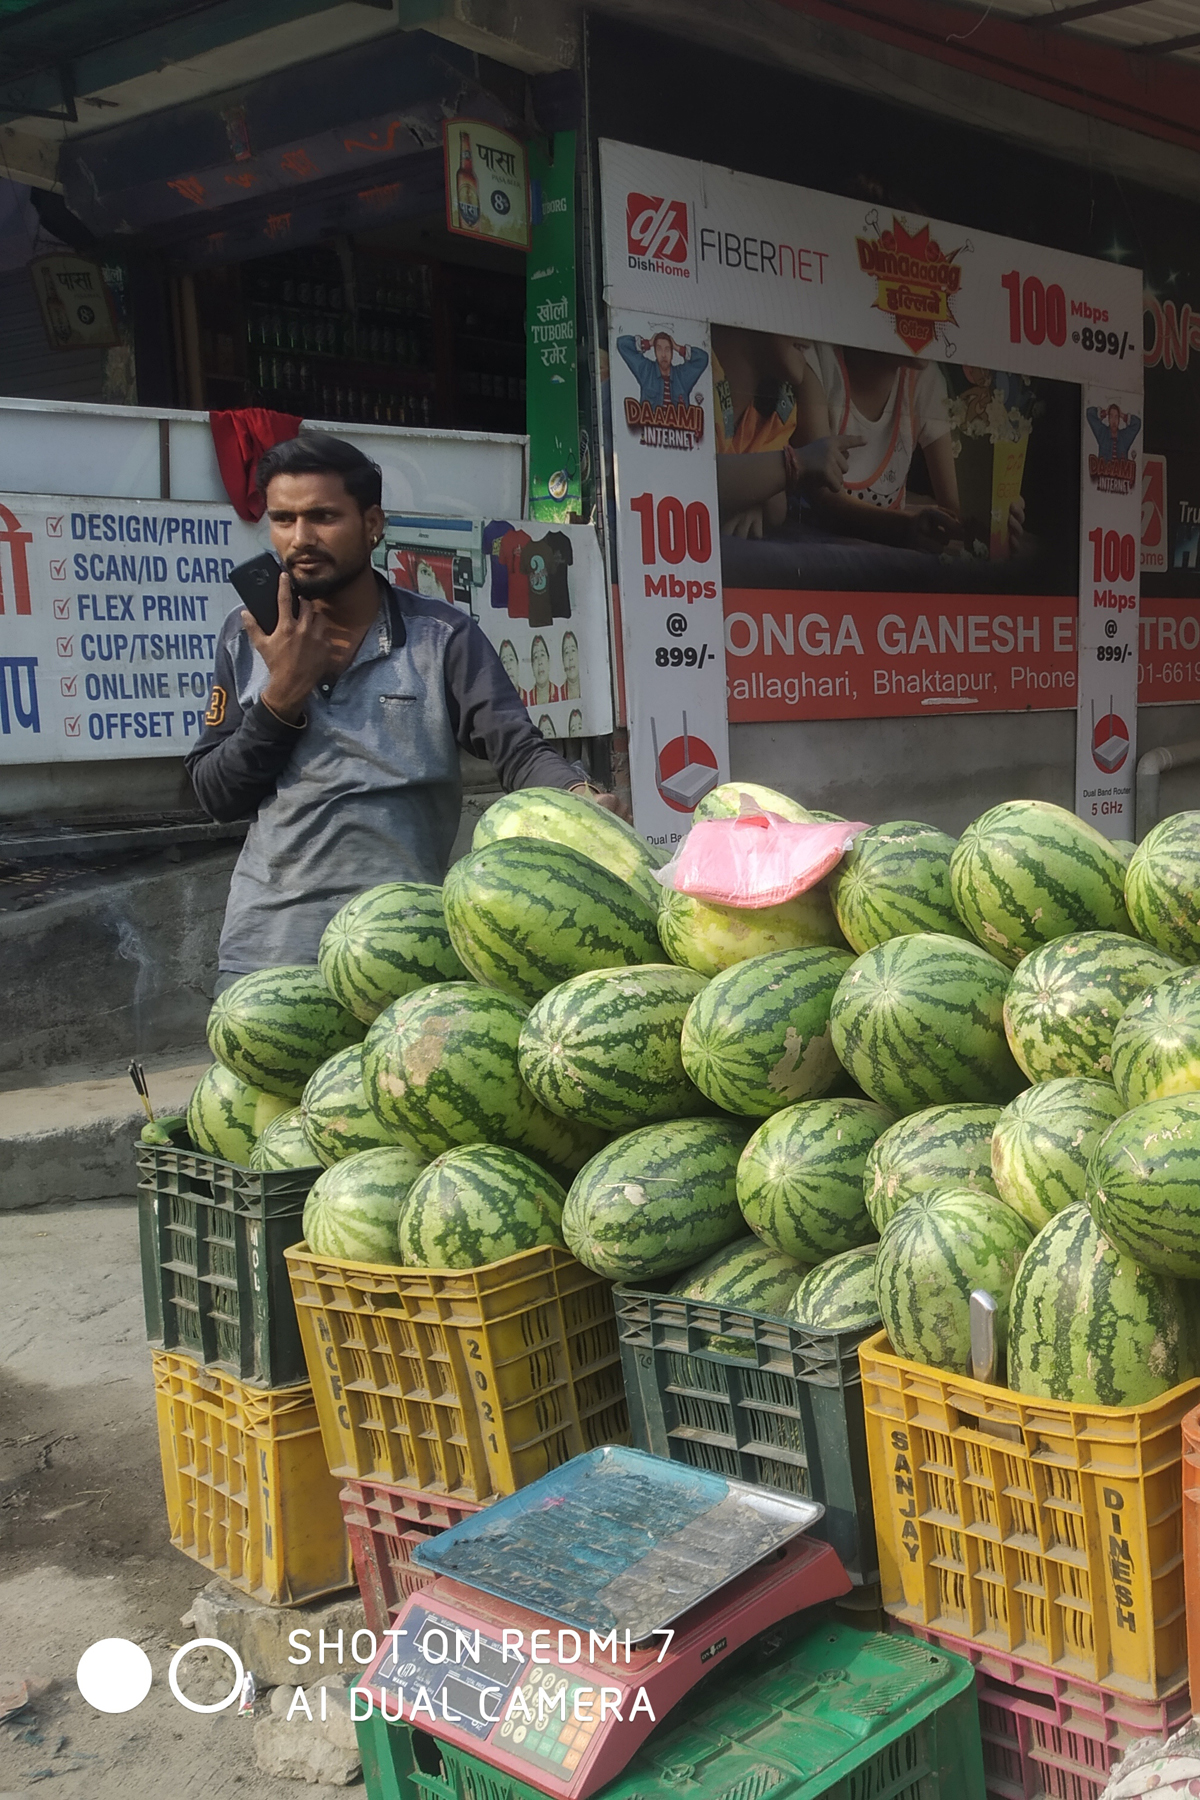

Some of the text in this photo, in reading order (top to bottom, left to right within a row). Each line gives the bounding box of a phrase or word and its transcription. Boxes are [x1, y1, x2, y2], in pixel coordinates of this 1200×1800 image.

[476, 143, 517, 178] पासा
[542, 198, 567, 215] UBORG
[628, 255, 690, 279] DishHome
[1001, 270, 1109, 347] 100 Mbps
[531, 320, 573, 344] TUBORG
[898, 320, 929, 340] Offer
[644, 426, 696, 449] INTERNET
[1098, 477, 1130, 494] INTERNET
[70, 513, 233, 546] DESIGN/PRINT
[630, 492, 712, 566] 100
[1089, 527, 1136, 583] 100
[73, 553, 235, 585] SCAN/ID CARD
[644, 573, 717, 604] Mbps
[1093, 589, 1136, 613] Mbps
[77, 594, 209, 621] FLEX PRINT
[666, 612, 688, 637] @
[724, 611, 865, 657] ONGA
[876, 613, 1040, 654] GANESH
[1104, 619, 1118, 638] @
[80, 633, 216, 663] CUP/TSHIRT
[655, 643, 715, 669] 899/-
[1096, 643, 1133, 663] 899/-
[85, 671, 213, 701] ONLINE FO
[873, 668, 998, 697] Bhaktapur,
[88, 711, 175, 740] OFFSET
[1083, 786, 1131, 798] Dual Band Router
[1091, 801, 1123, 816] 5 GHz
[646, 834, 668, 846] Dual
[890, 1430, 920, 1562] SANJAY
[1102, 1487, 1137, 1633] DINESH
